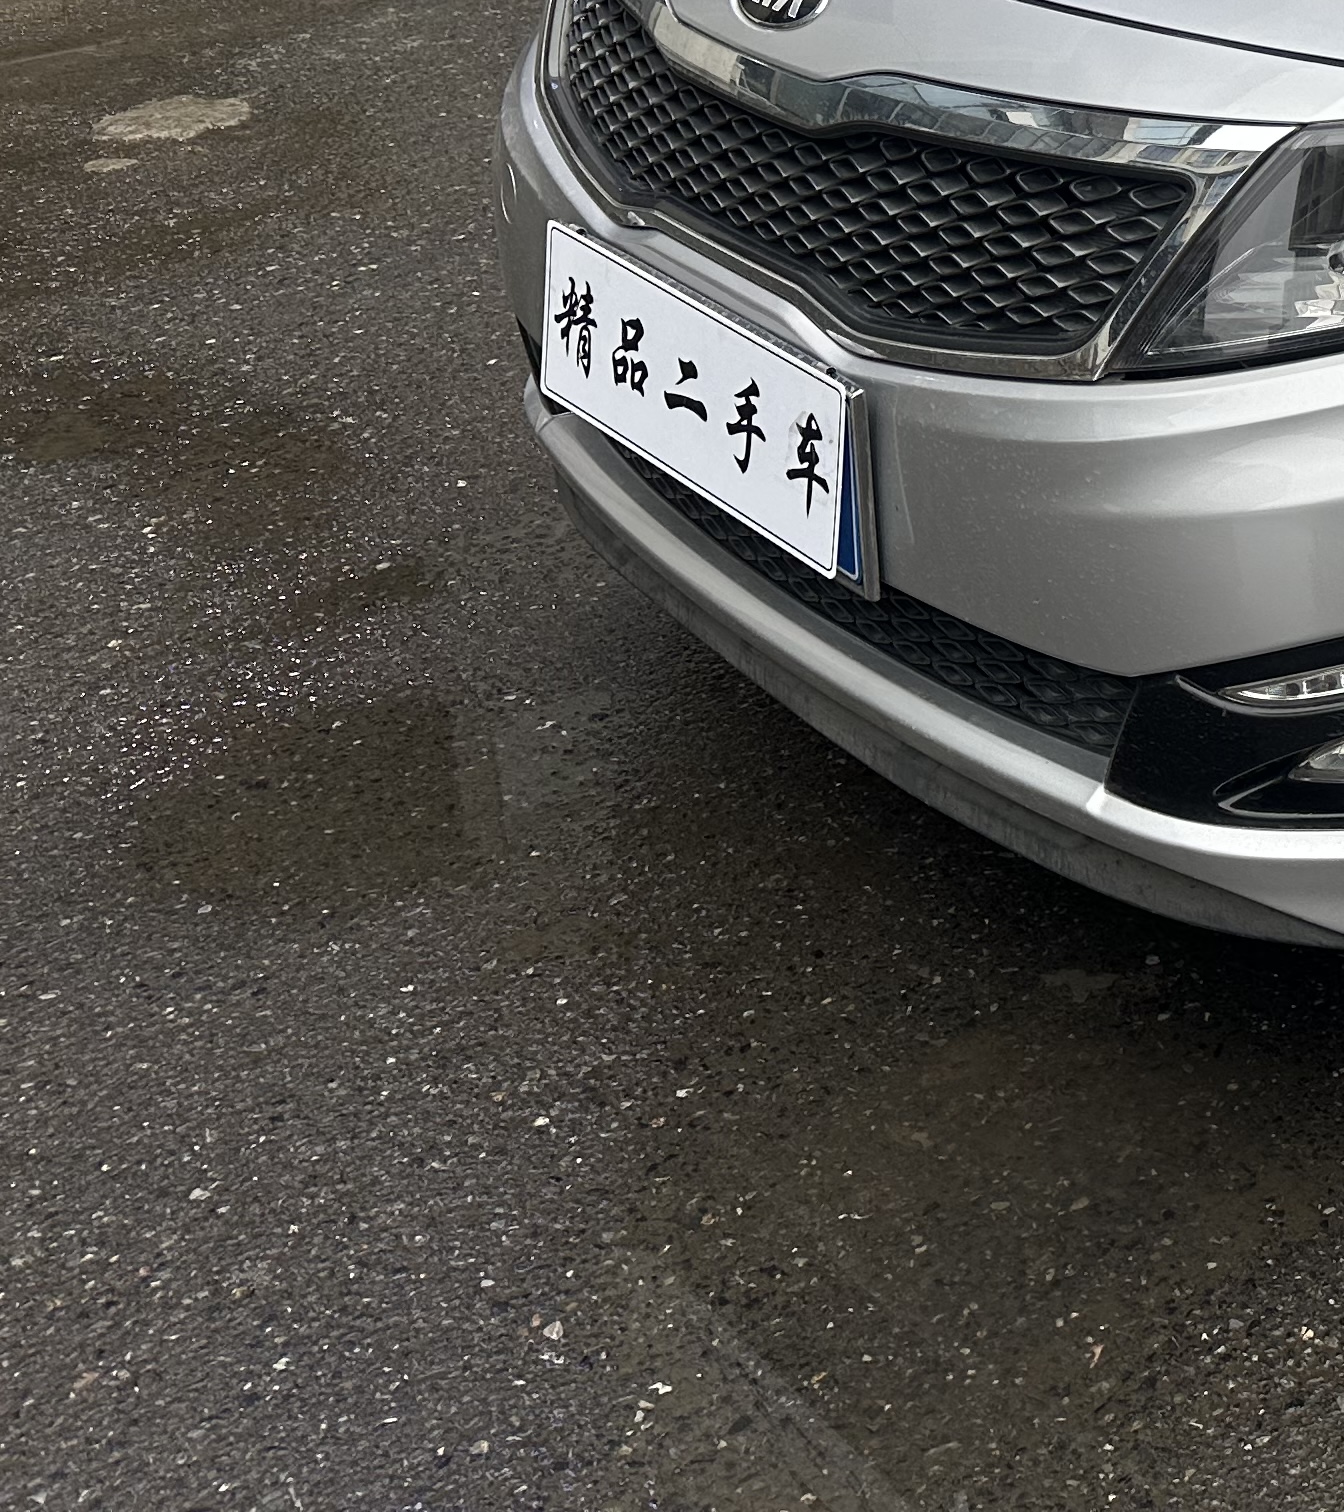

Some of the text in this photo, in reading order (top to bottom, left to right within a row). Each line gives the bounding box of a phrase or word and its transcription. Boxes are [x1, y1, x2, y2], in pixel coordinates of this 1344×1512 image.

[554, 278, 829, 517] 精品二手车
